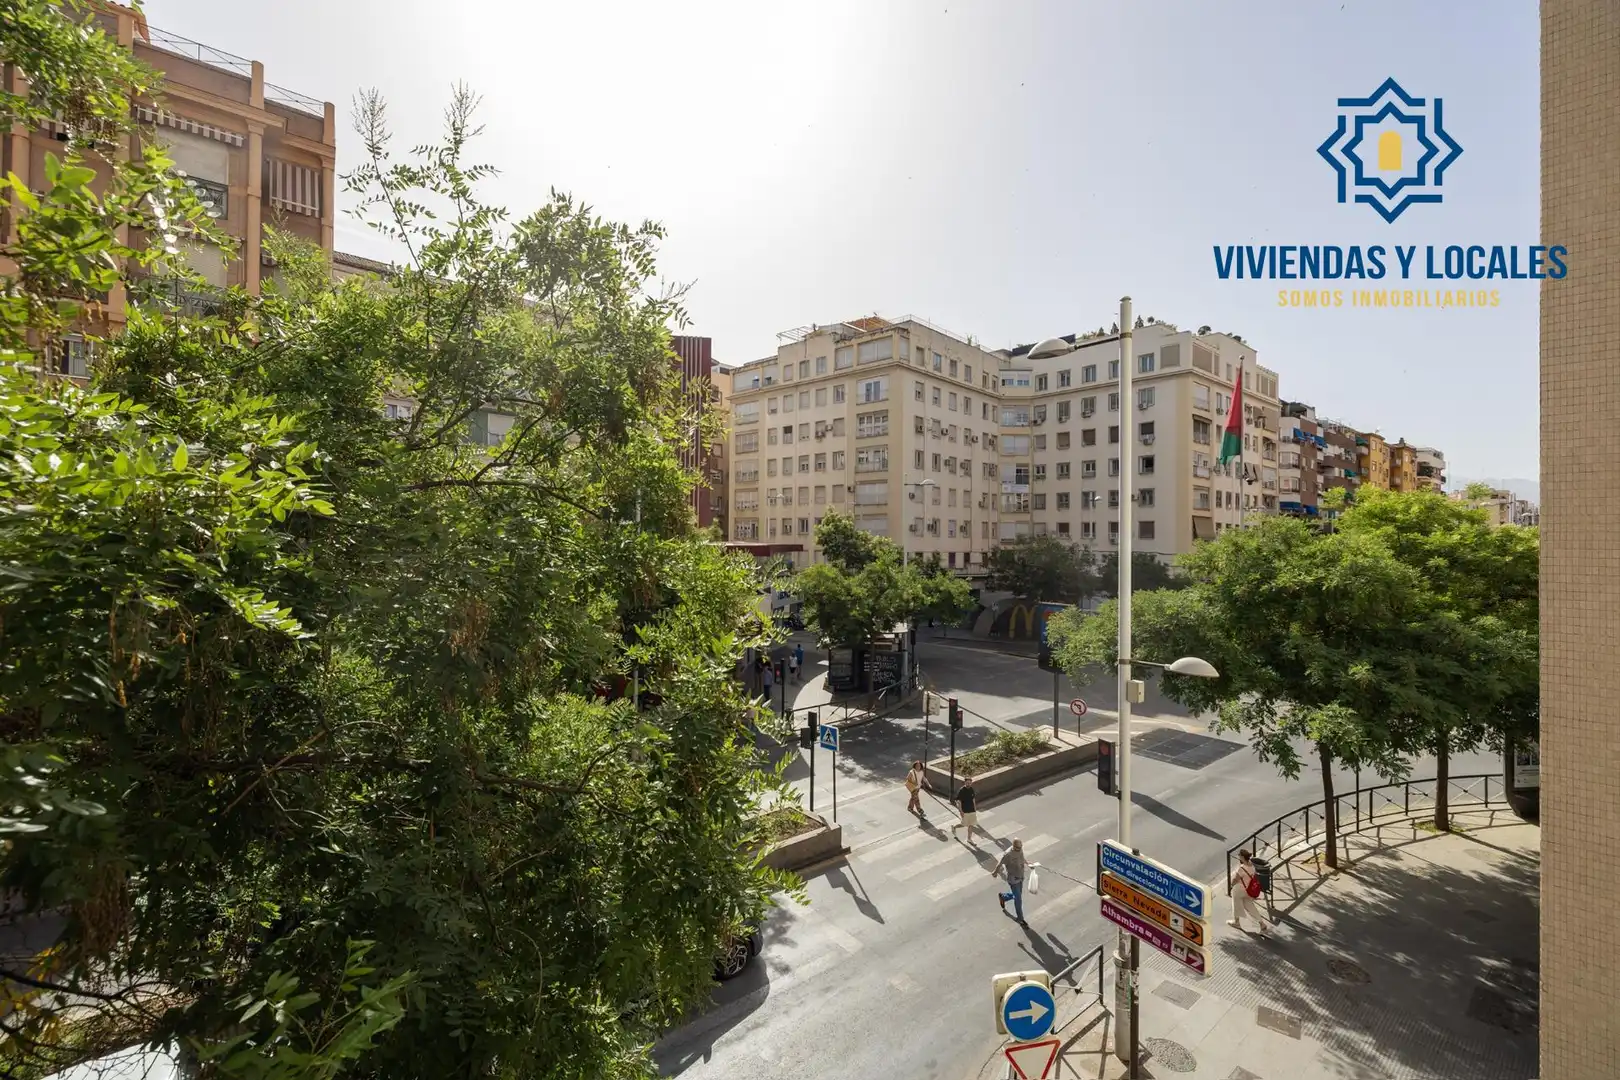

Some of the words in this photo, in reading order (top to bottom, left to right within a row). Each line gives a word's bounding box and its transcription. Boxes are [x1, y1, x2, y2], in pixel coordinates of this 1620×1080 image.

[1103, 846, 1169, 886] Circunvalación
[1103, 856, 1124, 873] (todas
[1125, 867, 1169, 896] direcciones)
[1102, 904, 1145, 935] Alhambra
[1103, 879, 1128, 900] Sierra
[1133, 896, 1168, 921] Nevada
